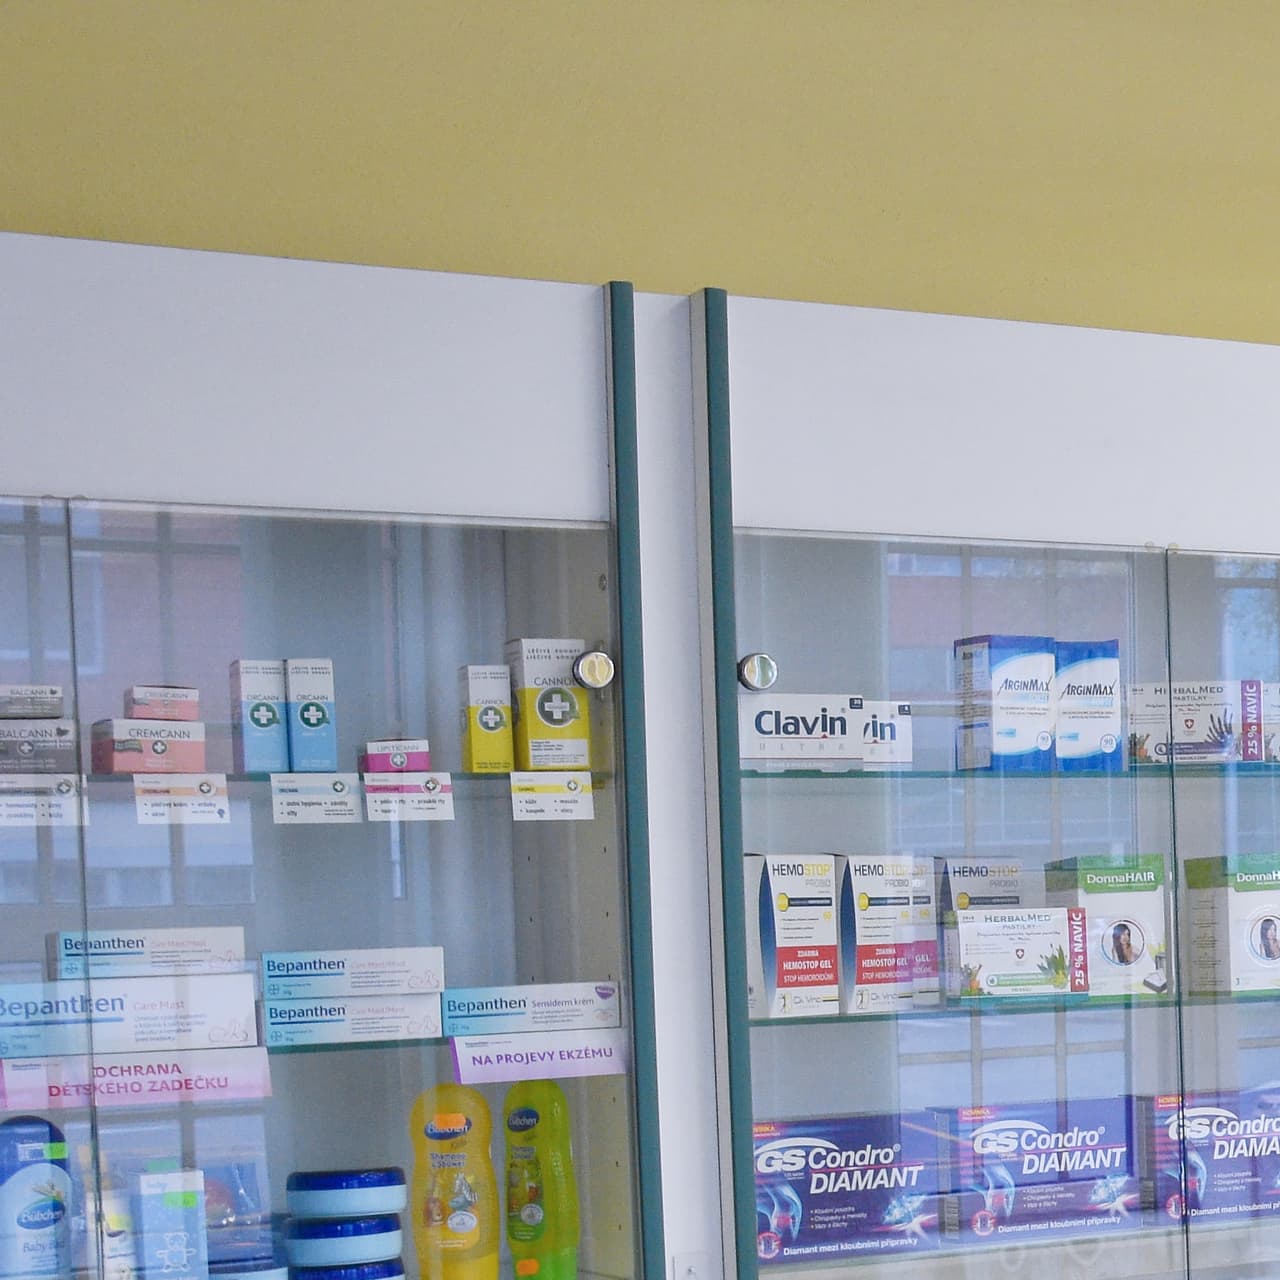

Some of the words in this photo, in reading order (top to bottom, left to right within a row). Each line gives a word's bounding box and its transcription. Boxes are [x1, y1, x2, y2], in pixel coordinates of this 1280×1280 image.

[755, 708, 846, 735] Clavin
[1246, 739, 1258, 755] 25
[1087, 870, 1156, 885] DonnaHAIR
[1072, 911, 1085, 951] NAVÍC
[267, 957, 345, 973] Bepanthen
[1073, 968, 1085, 987] 25
[269, 1004, 346, 1020] Bepanthen
[448, 997, 527, 1013] Bepanthen
[472, 1055, 493, 1066] NA
[496, 1050, 556, 1065] PROJEVY
[559, 1046, 613, 1061] EKZÉMU
[973, 1132, 1018, 1153] GS
[1020, 1126, 1099, 1151] Condro
[757, 1151, 806, 1173] GS
[808, 1145, 895, 1169] Condro
[1022, 1147, 1126, 1174] DIAMANT
[810, 1165, 923, 1194] DIAMANT
[784, 1244, 817, 1256] Diamant
[819, 1245, 838, 1253] mezi
